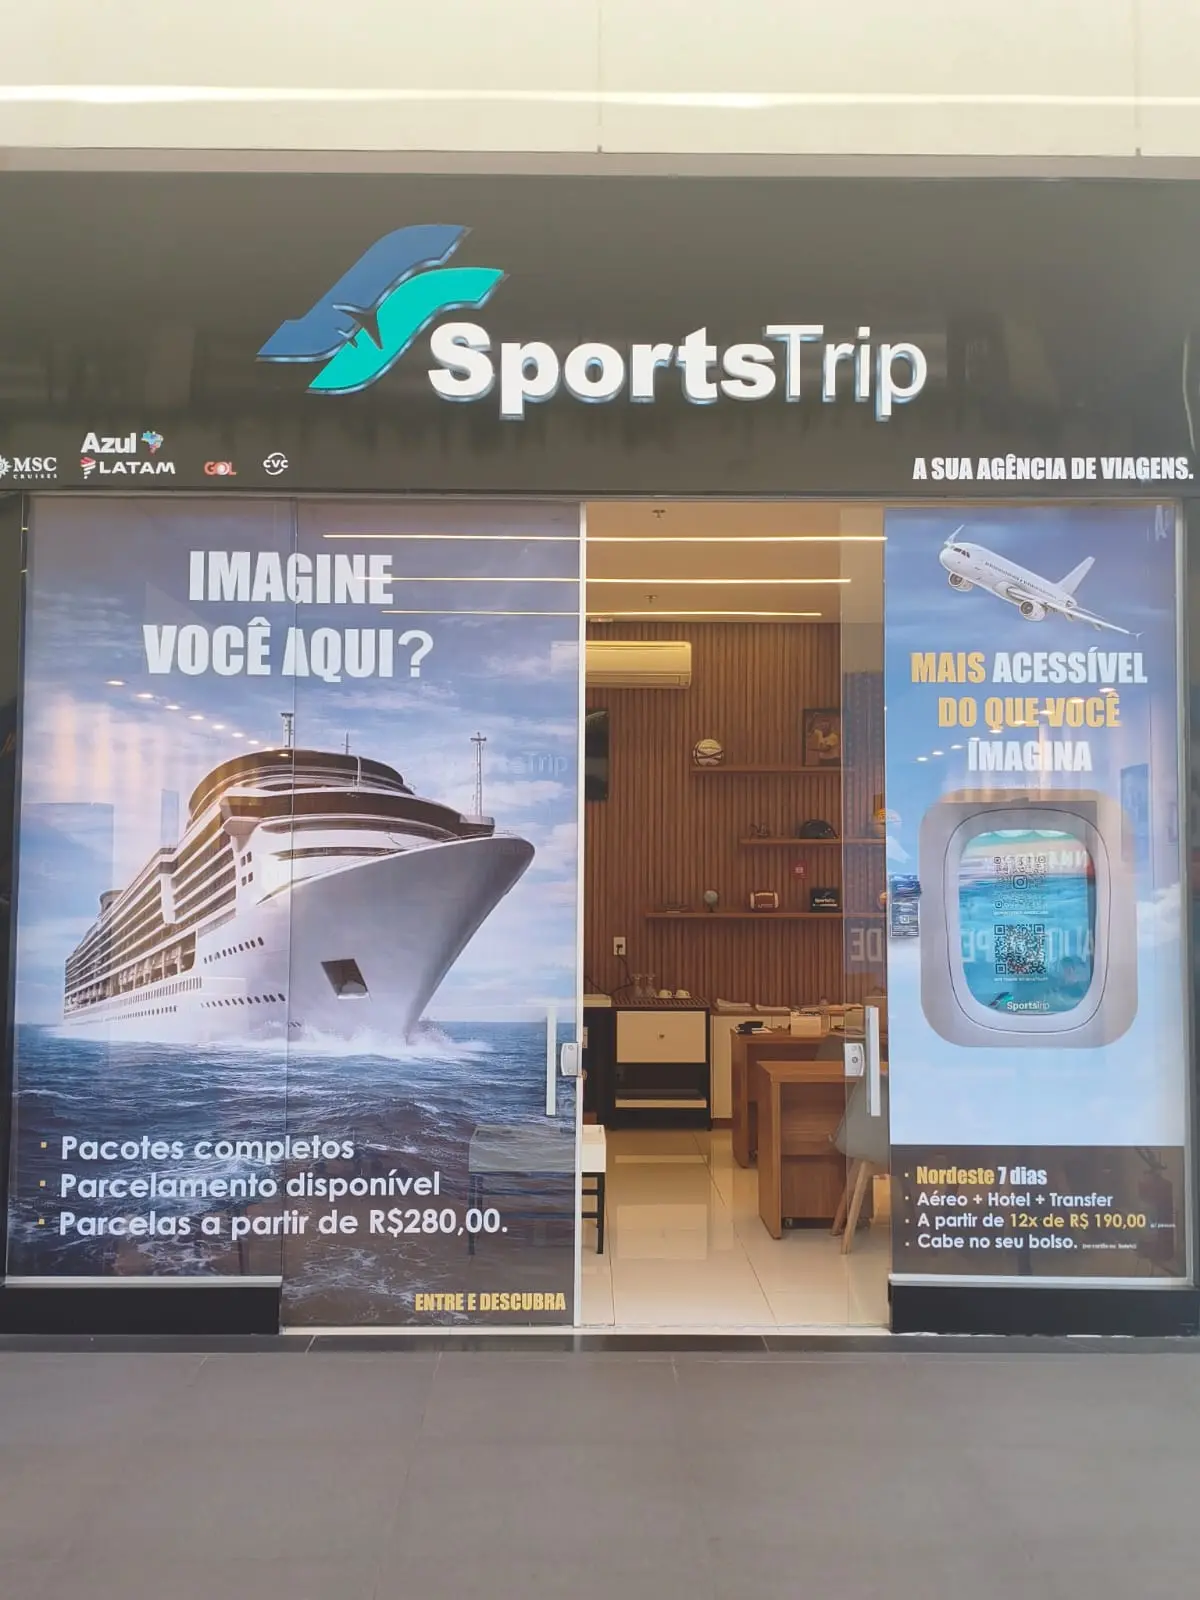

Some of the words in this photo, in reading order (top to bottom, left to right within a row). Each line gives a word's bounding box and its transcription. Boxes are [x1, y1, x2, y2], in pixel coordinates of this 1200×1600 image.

[428, 321, 928, 420] SportsTrip
[80, 432, 137, 453] Azul
[13, 457, 57, 472] MSC
[99, 461, 176, 474] LATAM
[204, 461, 237, 475] GOL
[263, 459, 289, 468] CVC
[912, 457, 927, 480] A
[931, 457, 973, 480] SUA
[976, 453, 1067, 480] AGÊNCIA
[1071, 457, 1096, 480] DE
[1100, 457, 1194, 480] VIAGENS.
[189, 551, 394, 605] IMAGINE
[142, 616, 272, 676] VOCÊ
[911, 652, 986, 683] MAIS
[992, 646, 1148, 684] ACESSÍVEL
[938, 697, 977, 728] DO
[984, 697, 1039, 731] QUE
[1046, 690, 1121, 728] VOCÊ
[968, 740, 1093, 772] IMAGINA
[61, 1135, 184, 1160] Pacotes
[193, 1135, 355, 1165] completos
[60, 1172, 278, 1198] Parcelamento
[286, 1168, 440, 1202] disponível
[916, 1166, 995, 1185] Nordeste
[997, 1166, 1008, 1185] 7
[1009, 1166, 1048, 1186] dias
[917, 1190, 968, 1207] Aéreo
[972, 1194, 983, 1205] +
[987, 1192, 1031, 1207] Hotel
[1035, 1194, 1045, 1205] +
[1049, 1192, 1114, 1207] Transfer
[59, 1211, 191, 1236] Parcelas
[201, 1216, 221, 1236] a
[231, 1209, 309, 1241] partir
[318, 1209, 359, 1235] de
[369, 1207, 508, 1238] R$280,00.
[917, 1212, 930, 1228] A
[935, 1213, 978, 1231] partir
[982, 1213, 1005, 1228] de
[1010, 1213, 1038, 1228] 12x
[1043, 1213, 1065, 1228] de
[1070, 1213, 1089, 1230] R$
[1094, 1213, 1146, 1230] 190,00
[918, 1233, 965, 1249] Cabe
[969, 1236, 990, 1249] no
[995, 1236, 1024, 1249] seu
[1028, 1234, 1078, 1249] bolso.
[415, 1293, 464, 1311] ENTRE
[468, 1293, 476, 1311] E
[480, 1292, 566, 1311] DESCUBRA
